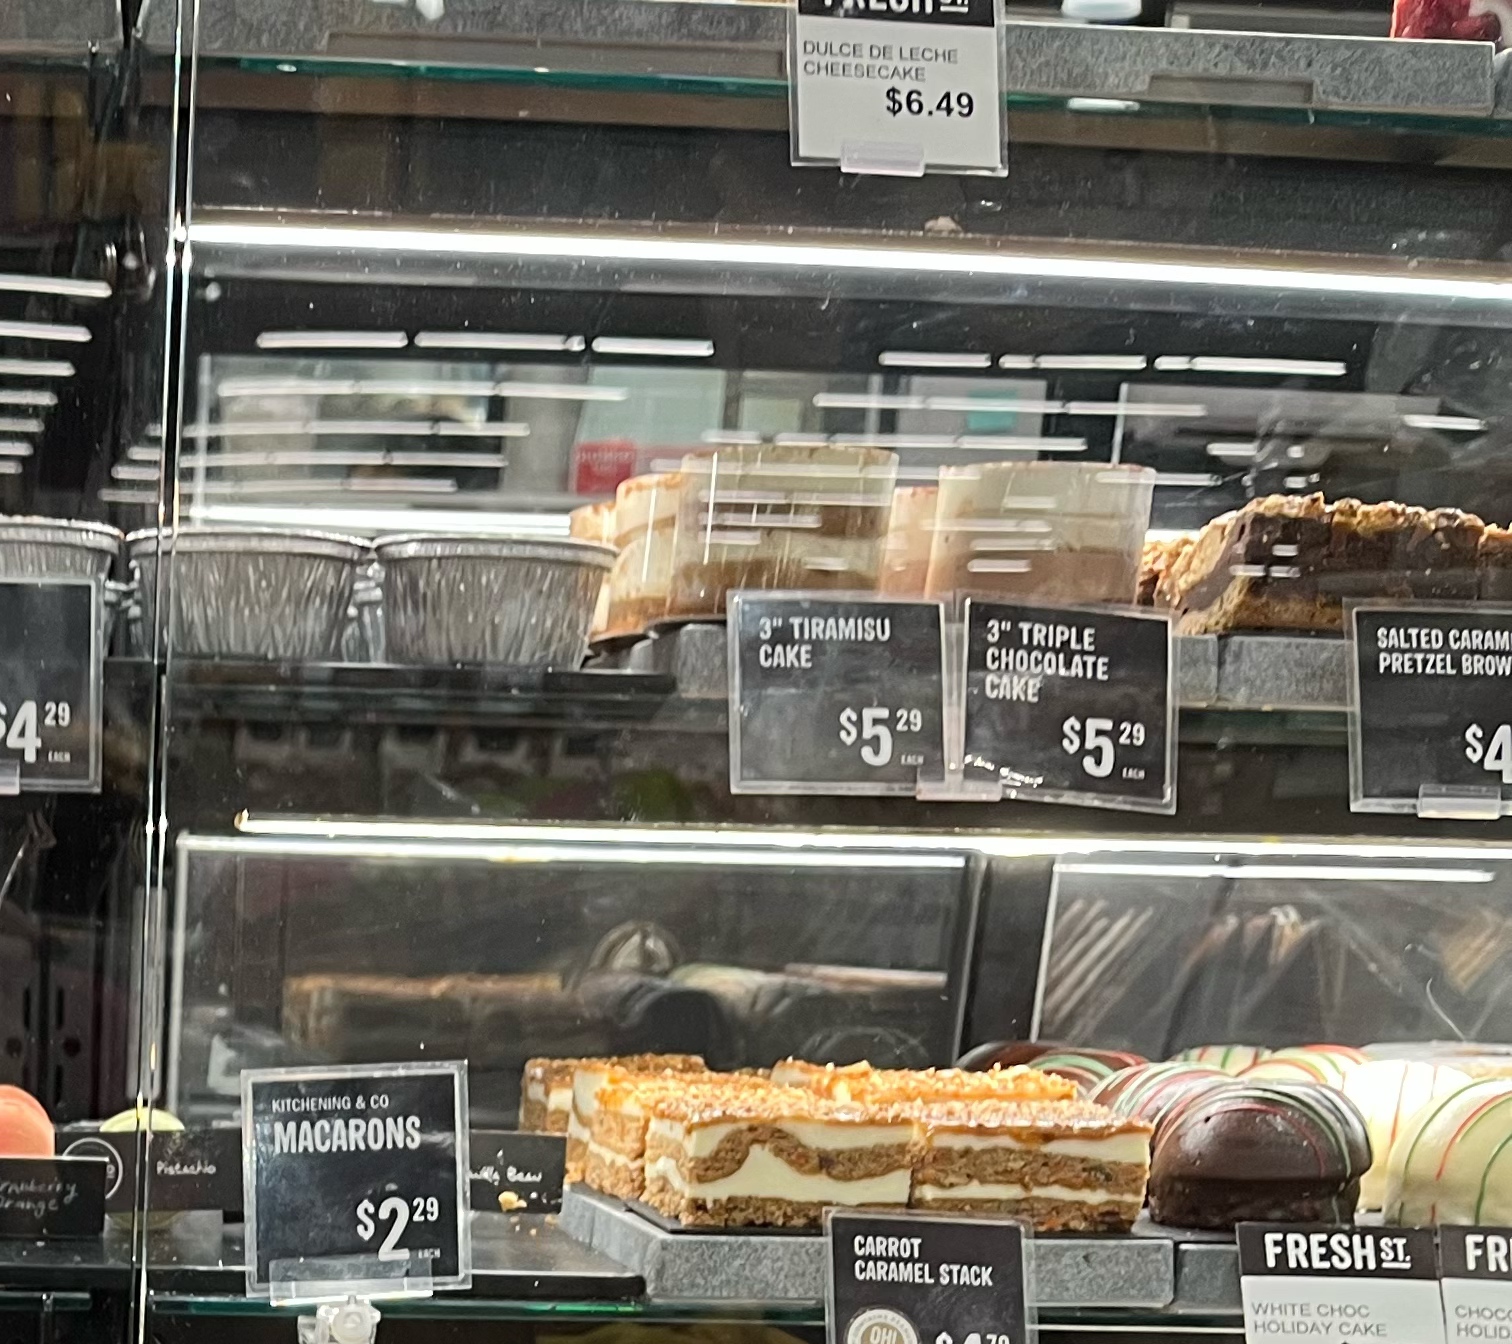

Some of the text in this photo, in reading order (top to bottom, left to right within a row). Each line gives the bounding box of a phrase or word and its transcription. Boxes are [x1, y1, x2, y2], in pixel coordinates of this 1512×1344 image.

[803, 40, 959, 64] DULCE DE LECHE
[803, 61, 926, 82] CHEESECAKE
[886, 86, 974, 118] $6.49
[759, 616, 891, 641] 3" TIRAMISU
[987, 618, 1096, 651] 3" TRIPLE
[1377, 627, 1512, 651] SALTED CARAM
[759, 643, 813, 668] CAKE
[986, 646, 1109, 681] CHOCOLATE
[1379, 652, 1457, 675] PRETZEL
[985, 673, 1040, 703] CAKE
[1465, 723, 1512, 783] $4
[272, 1094, 389, 1114] KITCHENING & CO
[273, 1115, 421, 1154] MACARONS
[156, 1160, 216, 1176] Pistachio
[854, 1235, 922, 1259] CARROT
[1264, 1232, 1377, 1270] FRESH
[1465, 1234, 1512, 1273] FR
[854, 1260, 993, 1287] CARAMEL STACK
[1251, 1303, 1370, 1318] WHITE CHOC
[1254, 1320, 1388, 1337] HOLIDAY CAKE
[1456, 1323, 1512, 1339] HOLID
